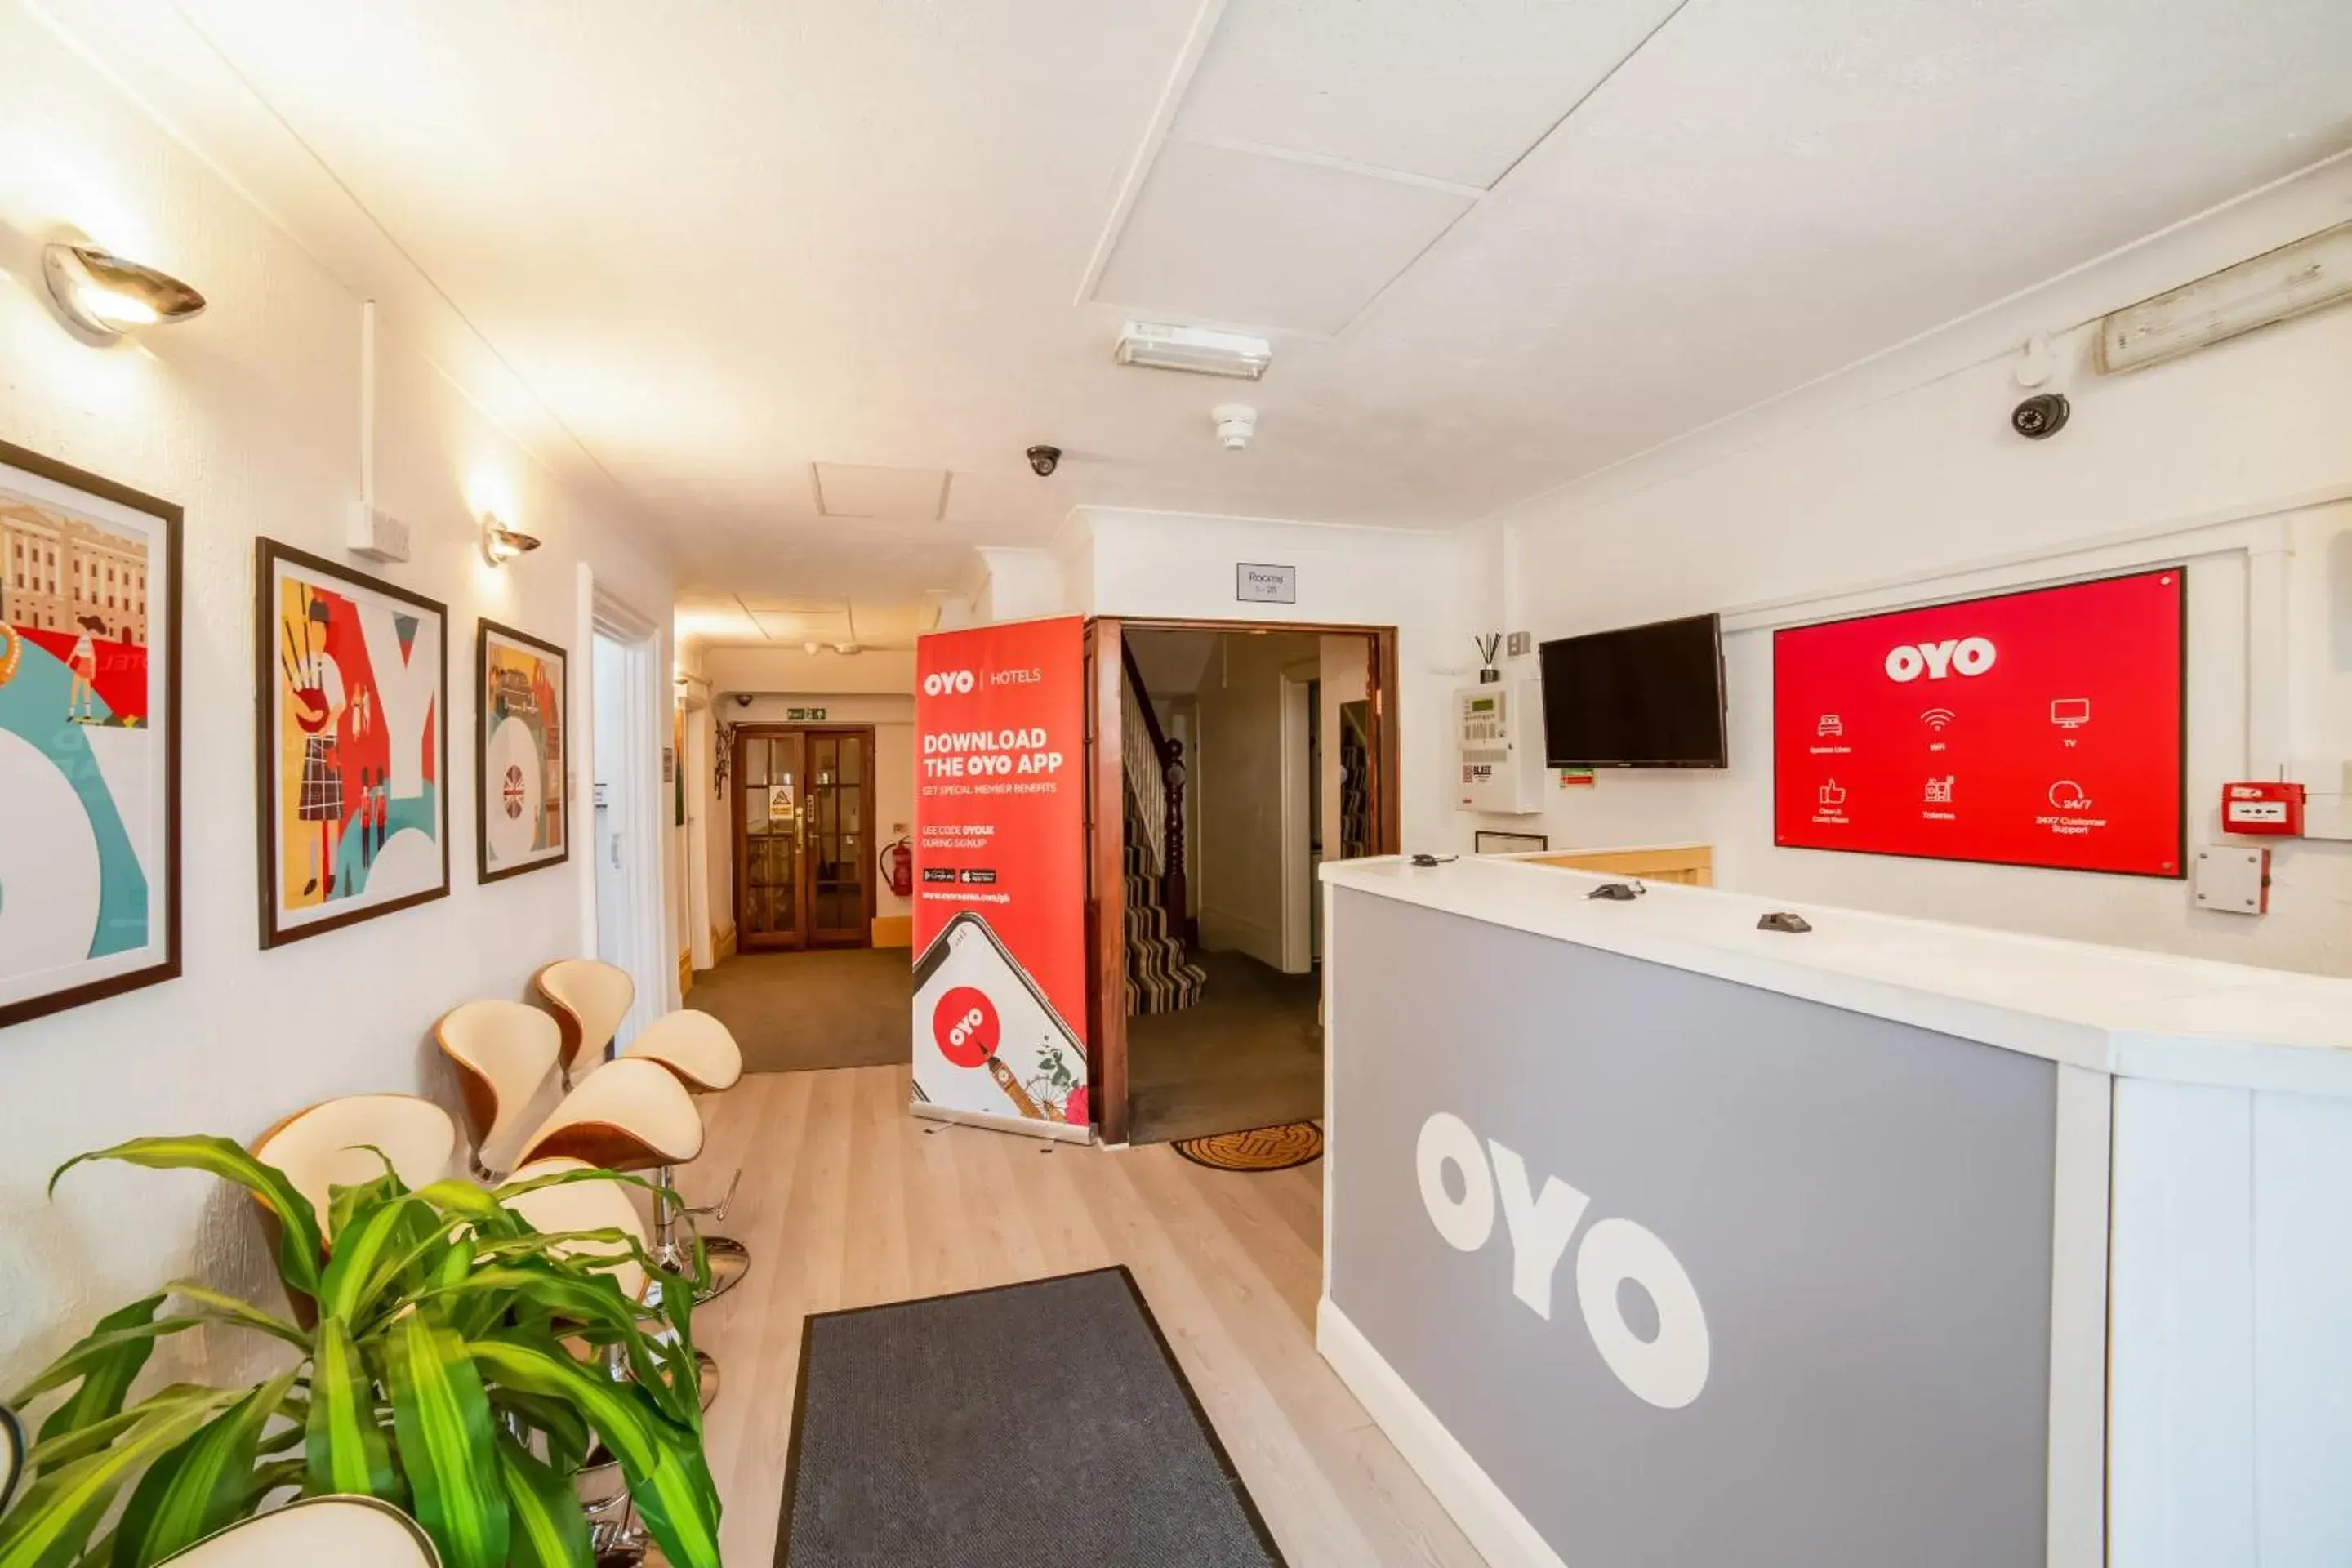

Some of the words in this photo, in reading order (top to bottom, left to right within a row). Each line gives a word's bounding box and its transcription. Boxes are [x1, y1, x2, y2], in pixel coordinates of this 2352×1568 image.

[1250, 572, 1285, 584] Rooms
[1884, 636, 1997, 683] OYO
[924, 670, 975, 697] OYO
[991, 668, 1042, 685] HOTELS
[924, 728, 1047, 754] DOWNLOAD
[2064, 739, 2078, 747] TV
[924, 756, 964, 777] THE
[967, 755, 1013, 776] OYO
[1018, 752, 1063, 775] APP
[922, 786, 938, 795] GET
[939, 785, 971, 795] SPECIAL
[974, 784, 1013, 795] MEMBER
[1013, 782, 1057, 794] BENEFITS
[2064, 800, 2092, 809] 24/7
[2060, 817, 2106, 826] Customer
[923, 826, 938, 835] USE
[939, 826, 962, 835] CODE
[962, 825, 995, 835] OYOUK
[2052, 824, 2088, 835] Support
[922, 838, 953, 849] DURING
[954, 838, 987, 849] SIGNUP
[949, 1008, 983, 1046] OYO
[1416, 1111, 1710, 1410] OYO
